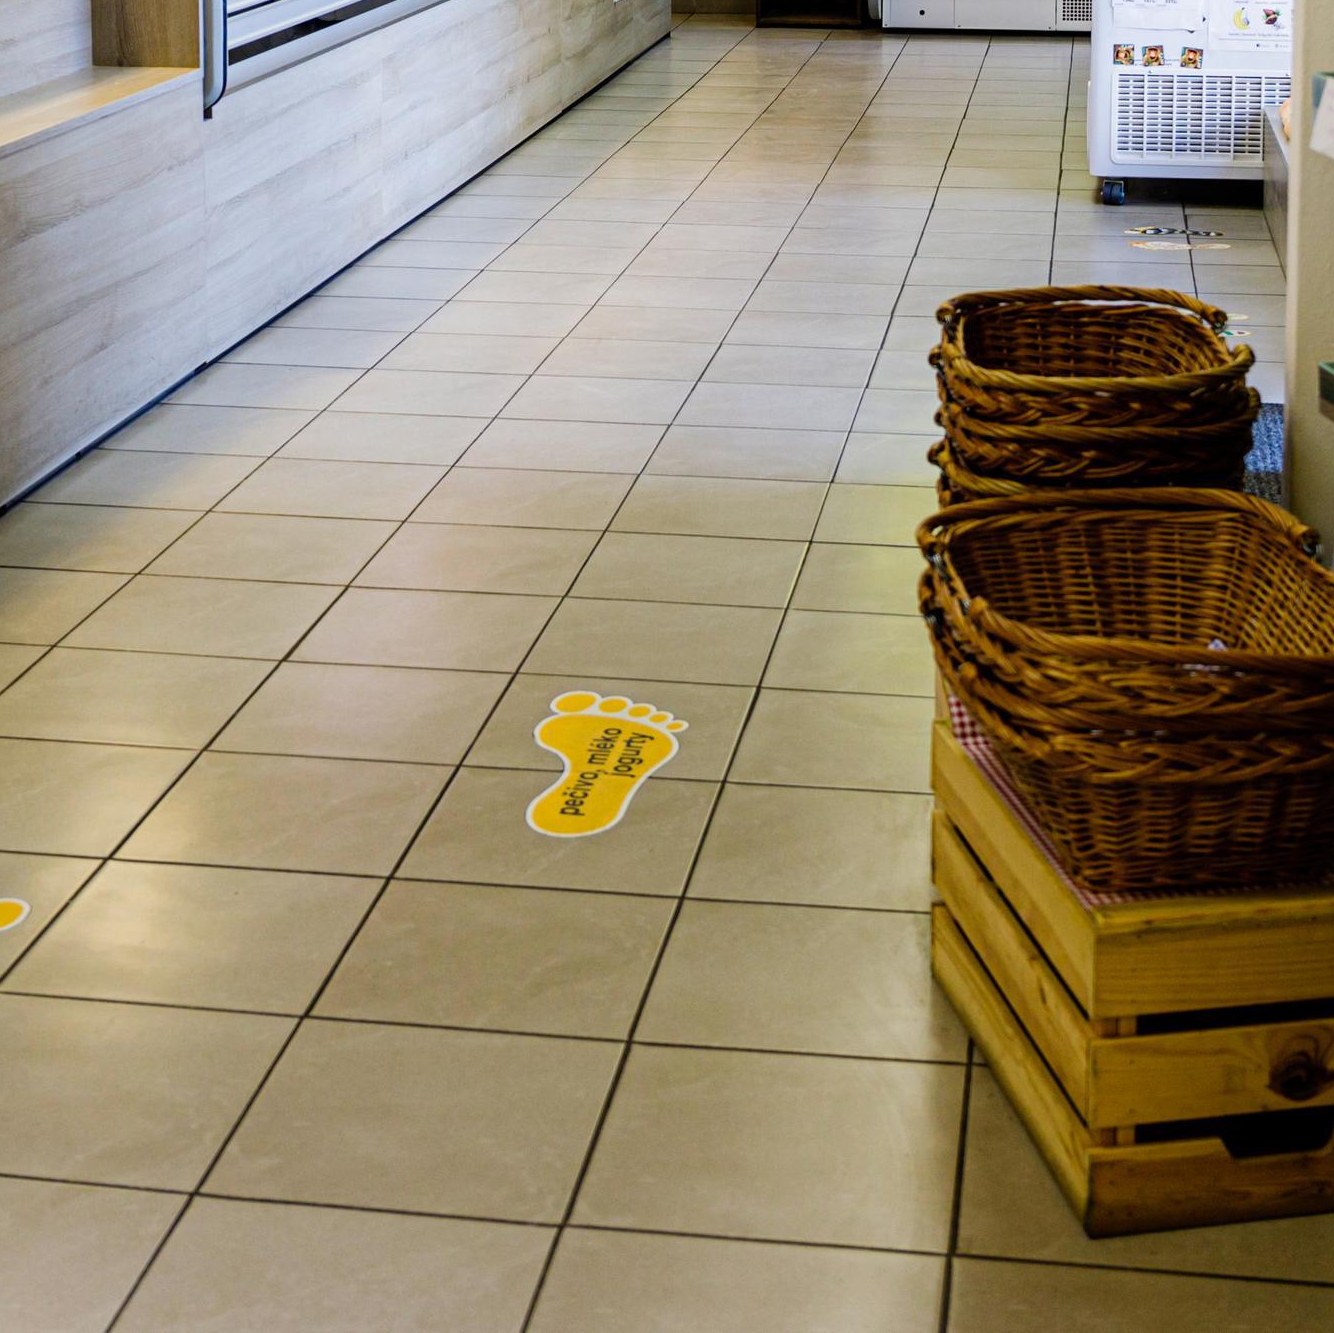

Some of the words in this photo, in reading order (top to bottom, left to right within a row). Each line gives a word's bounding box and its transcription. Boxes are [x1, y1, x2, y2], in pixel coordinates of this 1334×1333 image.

[558, 768, 609, 818] pečivo,
[587, 727, 623, 767] mléko
[610, 731, 656, 779] jogurty
